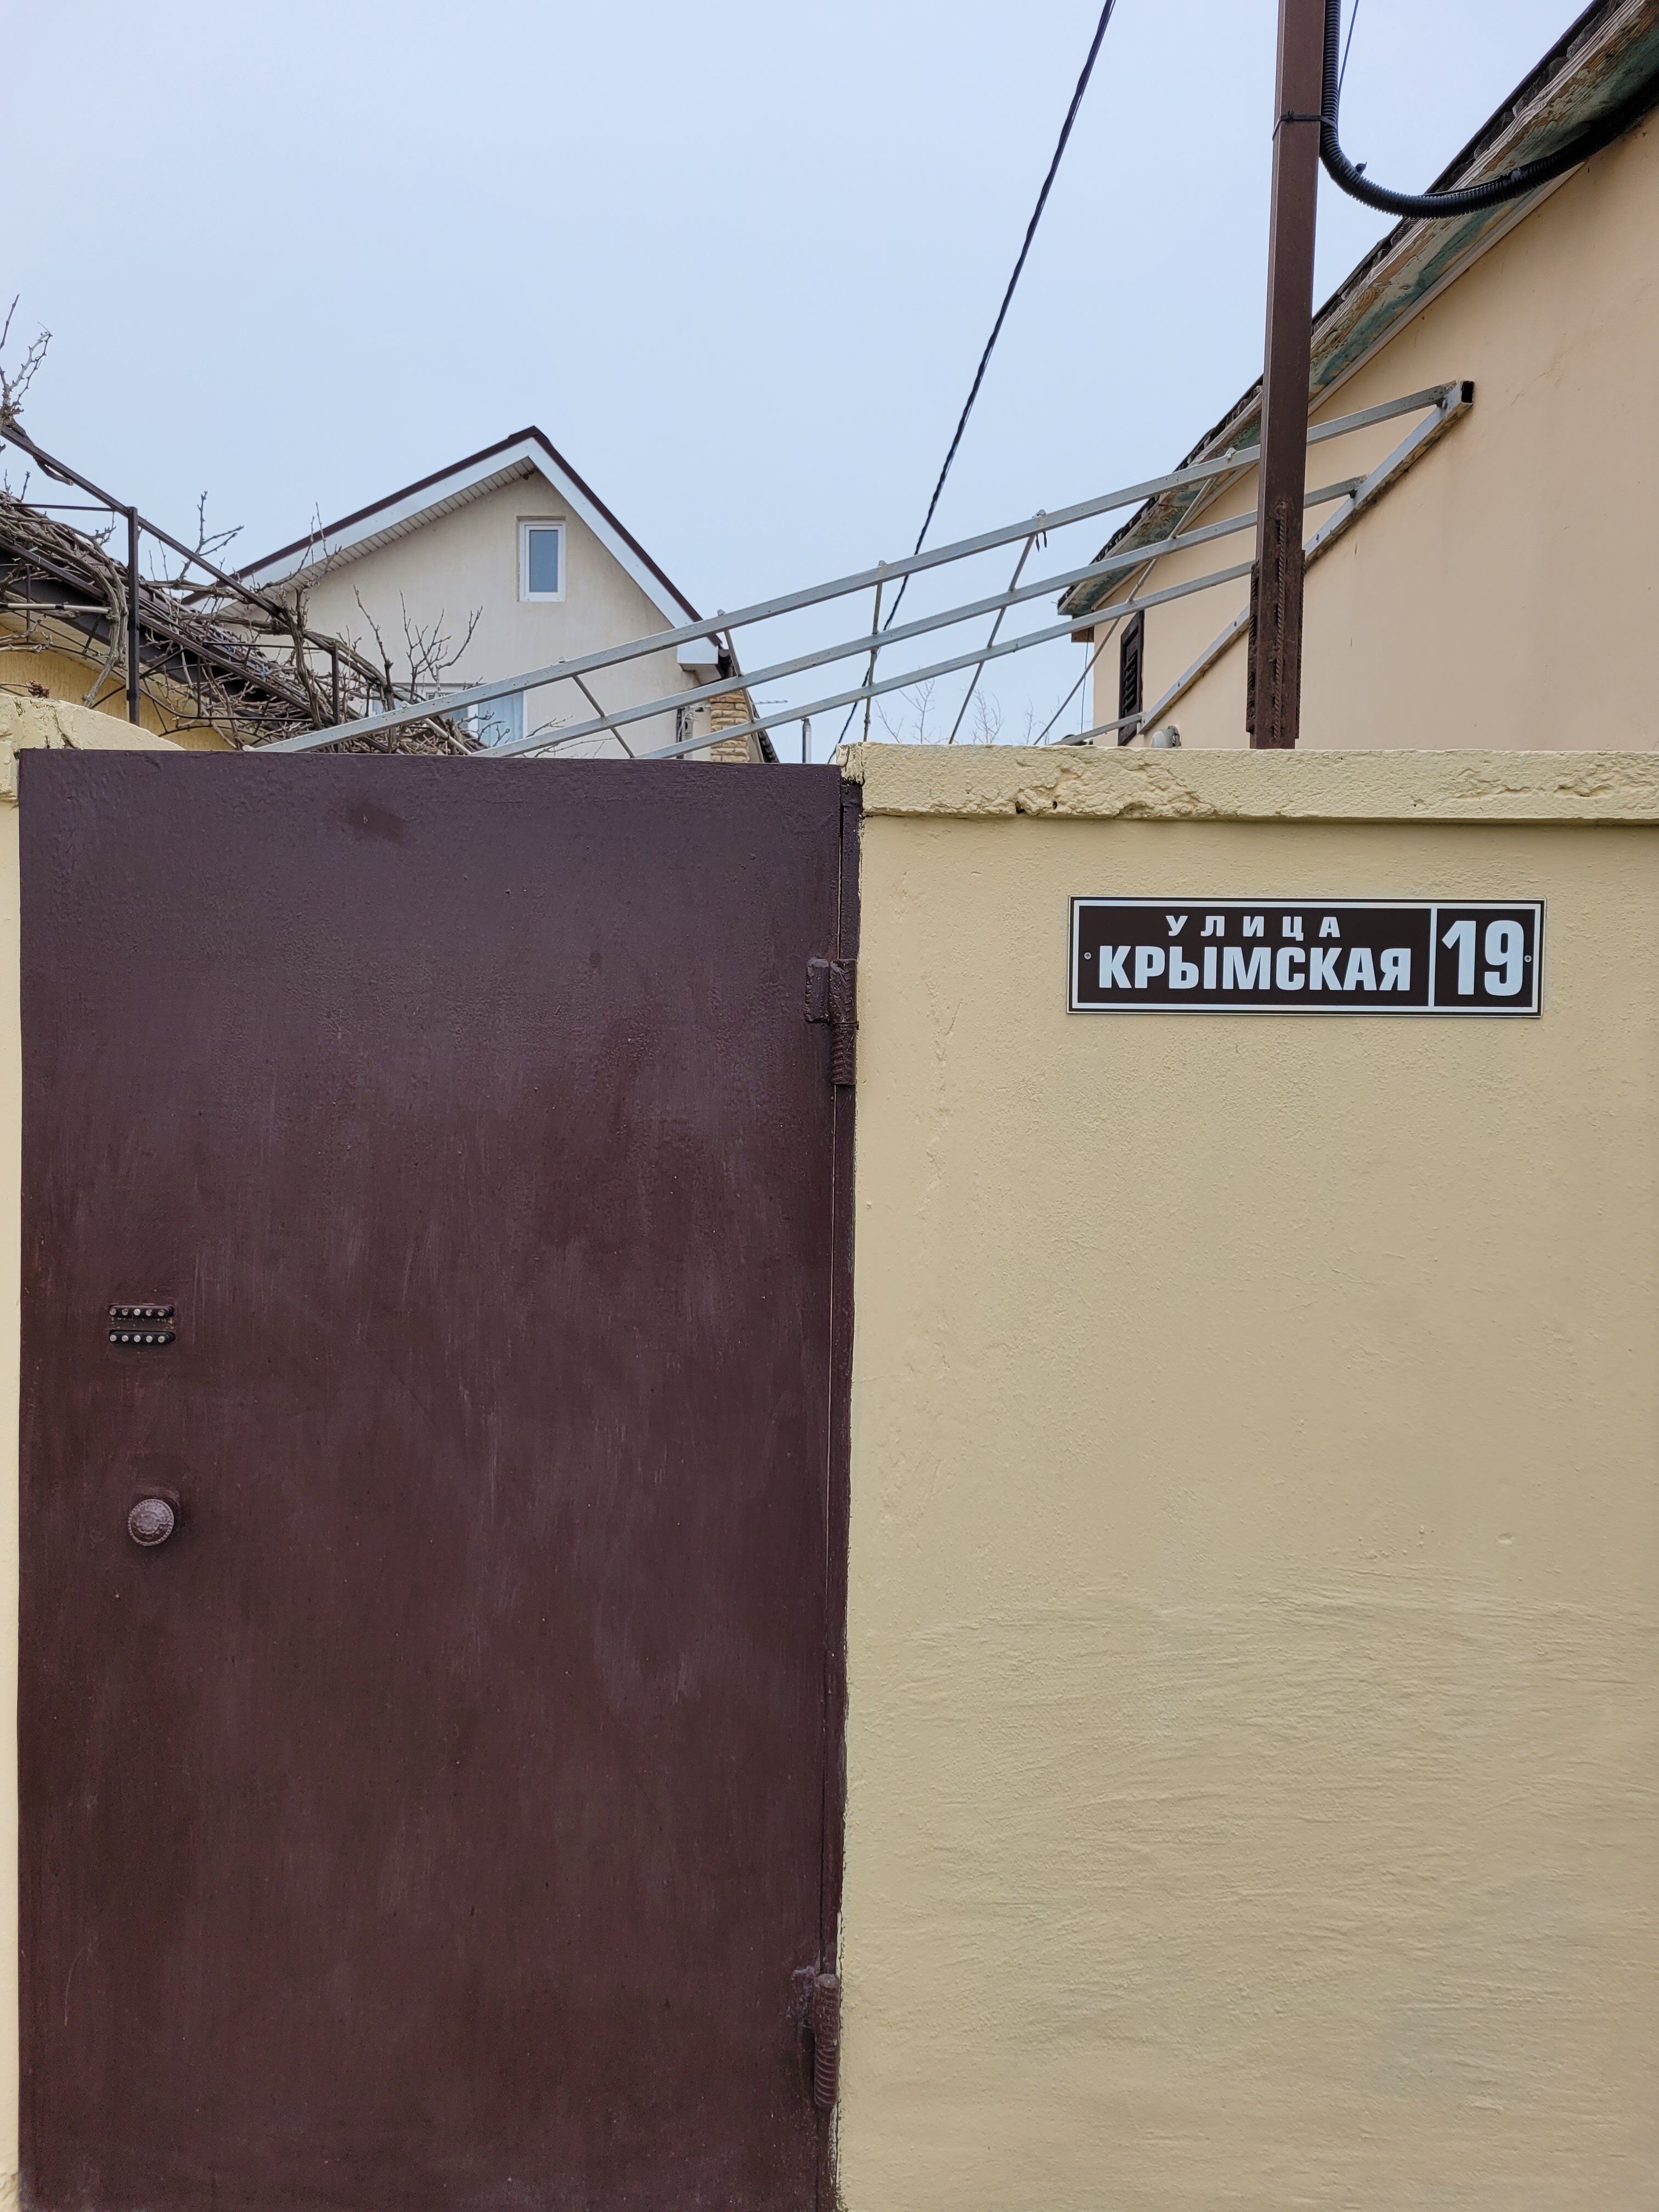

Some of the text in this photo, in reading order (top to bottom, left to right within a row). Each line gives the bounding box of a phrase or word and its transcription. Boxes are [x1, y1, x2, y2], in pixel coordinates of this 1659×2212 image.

[1166, 915, 1340, 941] УЛИЦА
[1099, 945, 1411, 991] КРЫМСКАЯ
[1442, 920, 1524, 996] 19
